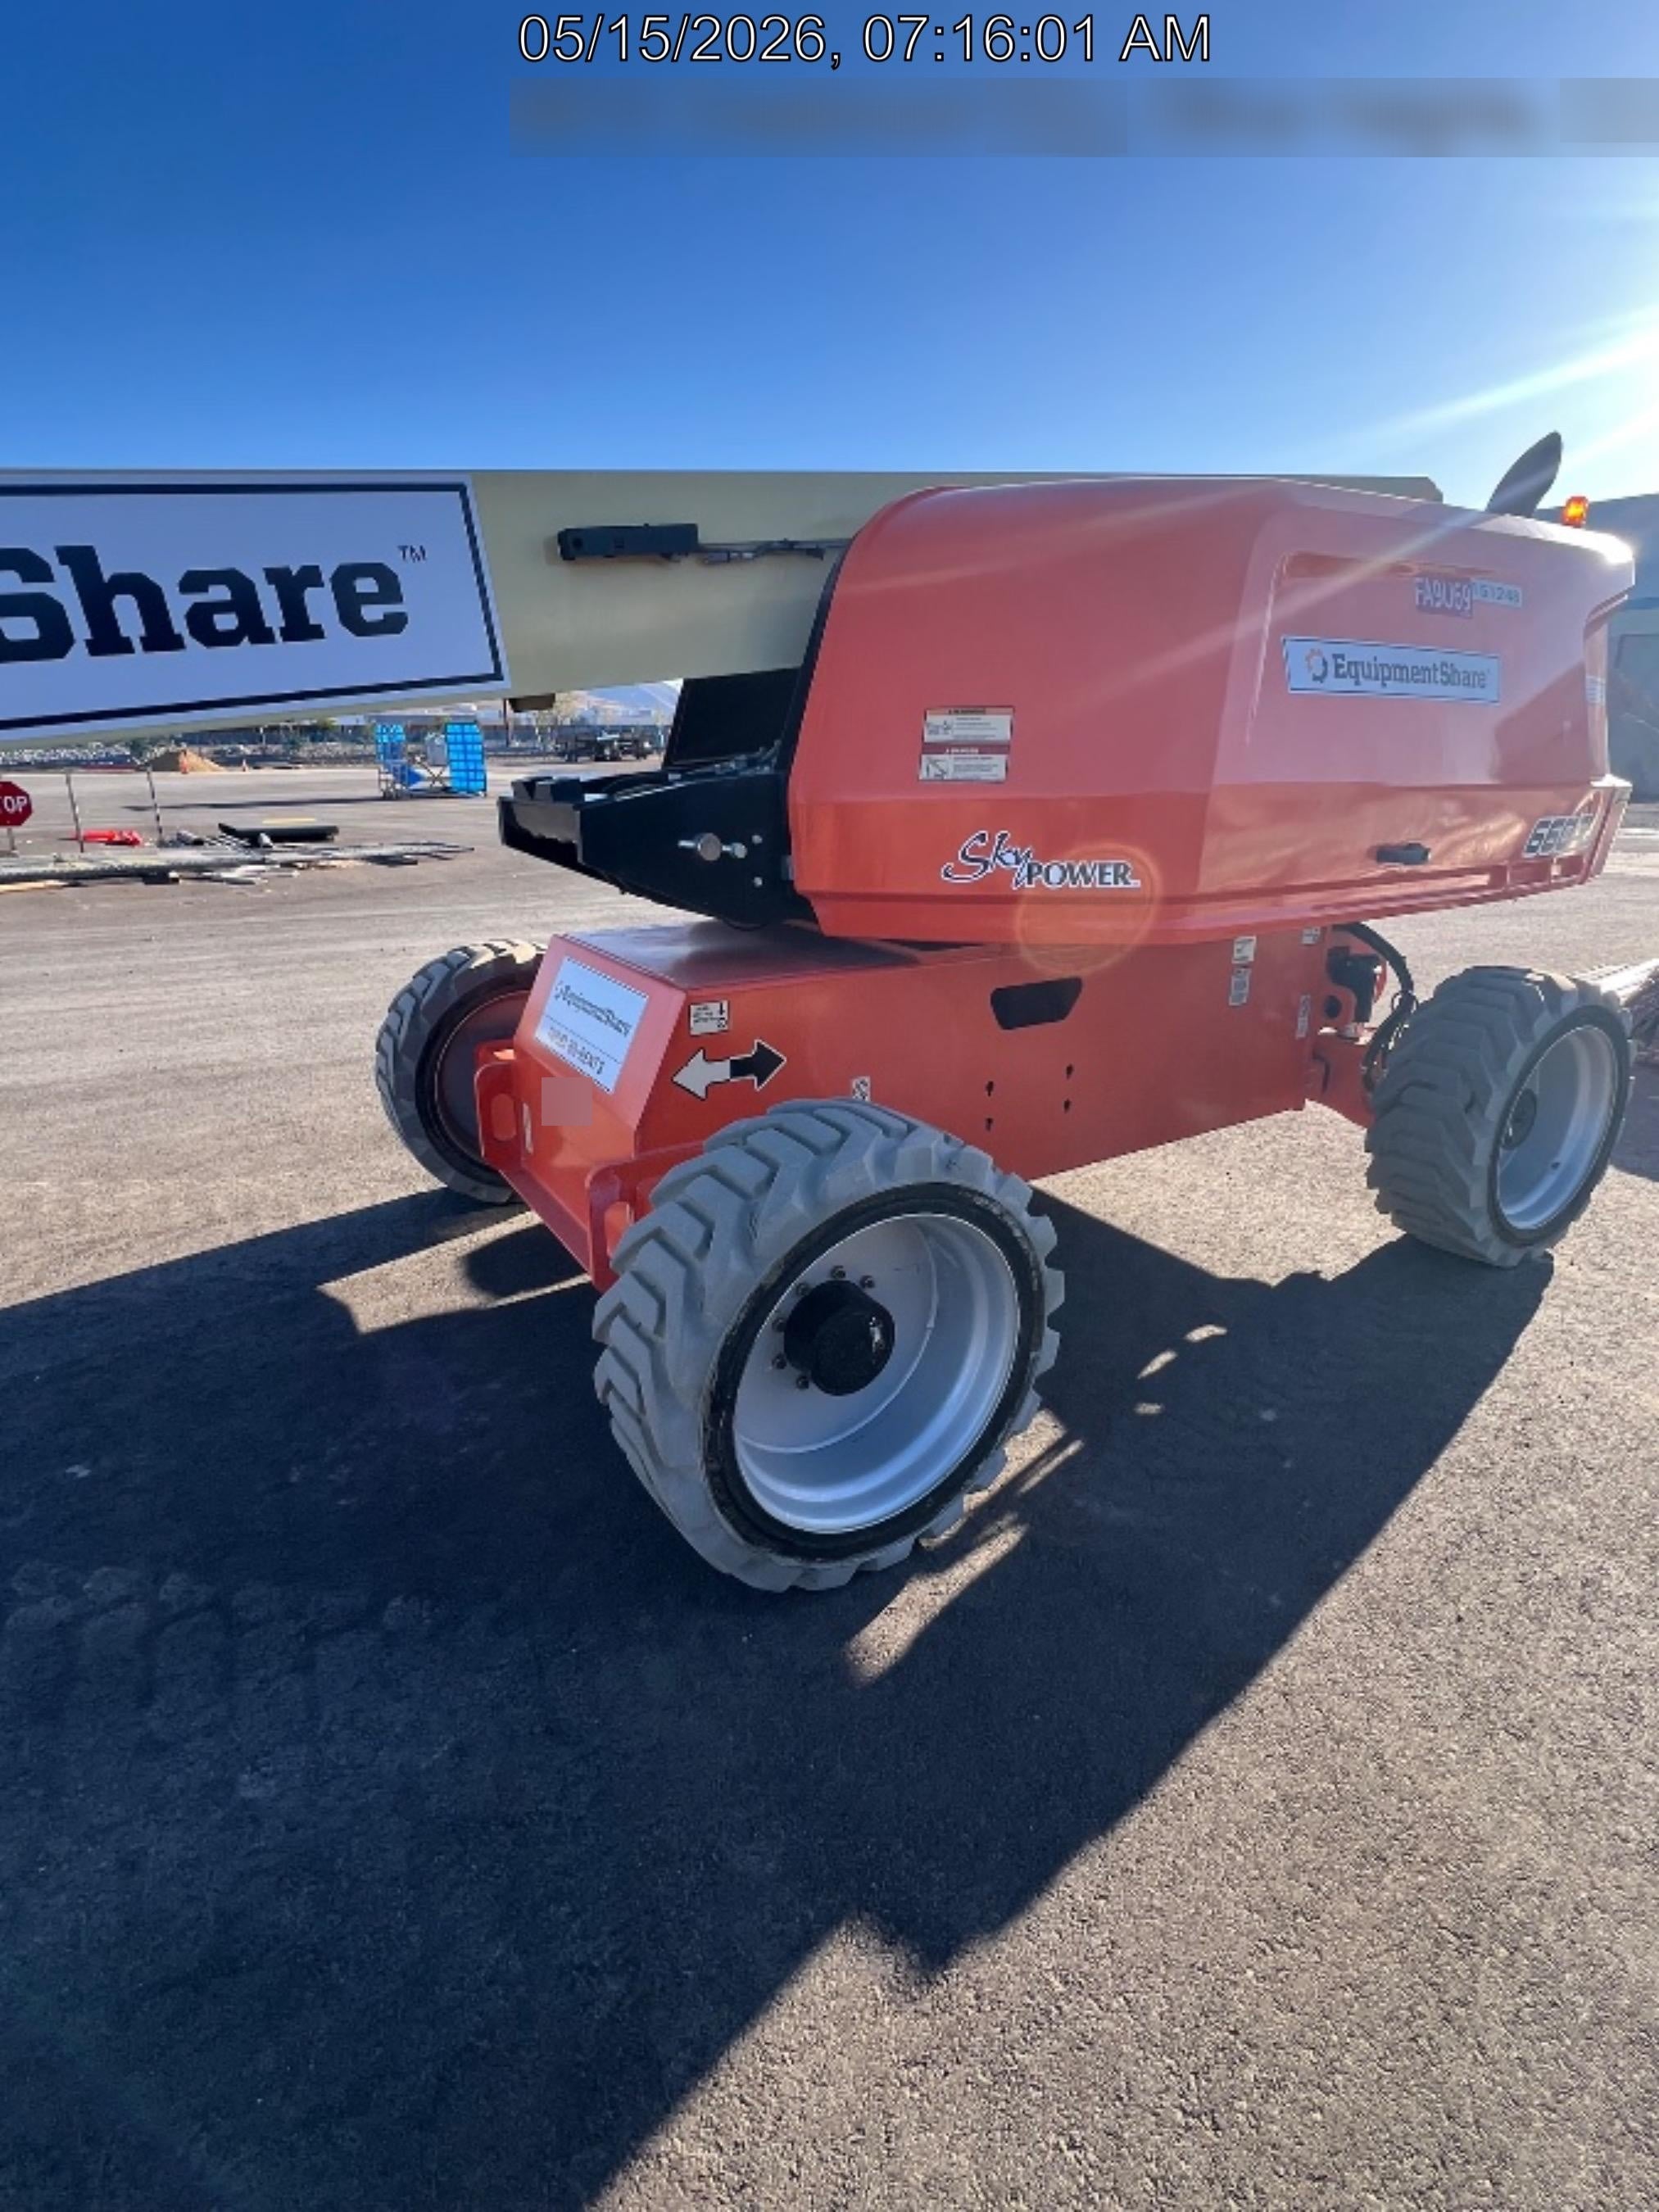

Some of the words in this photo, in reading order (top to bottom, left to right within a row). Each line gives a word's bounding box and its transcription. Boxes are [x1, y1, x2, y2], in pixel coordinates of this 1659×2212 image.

[1332, 653, 1487, 689] EquipmentShare
[0, 796, 27, 814] OP
[1025, 860, 1134, 888] POWER
